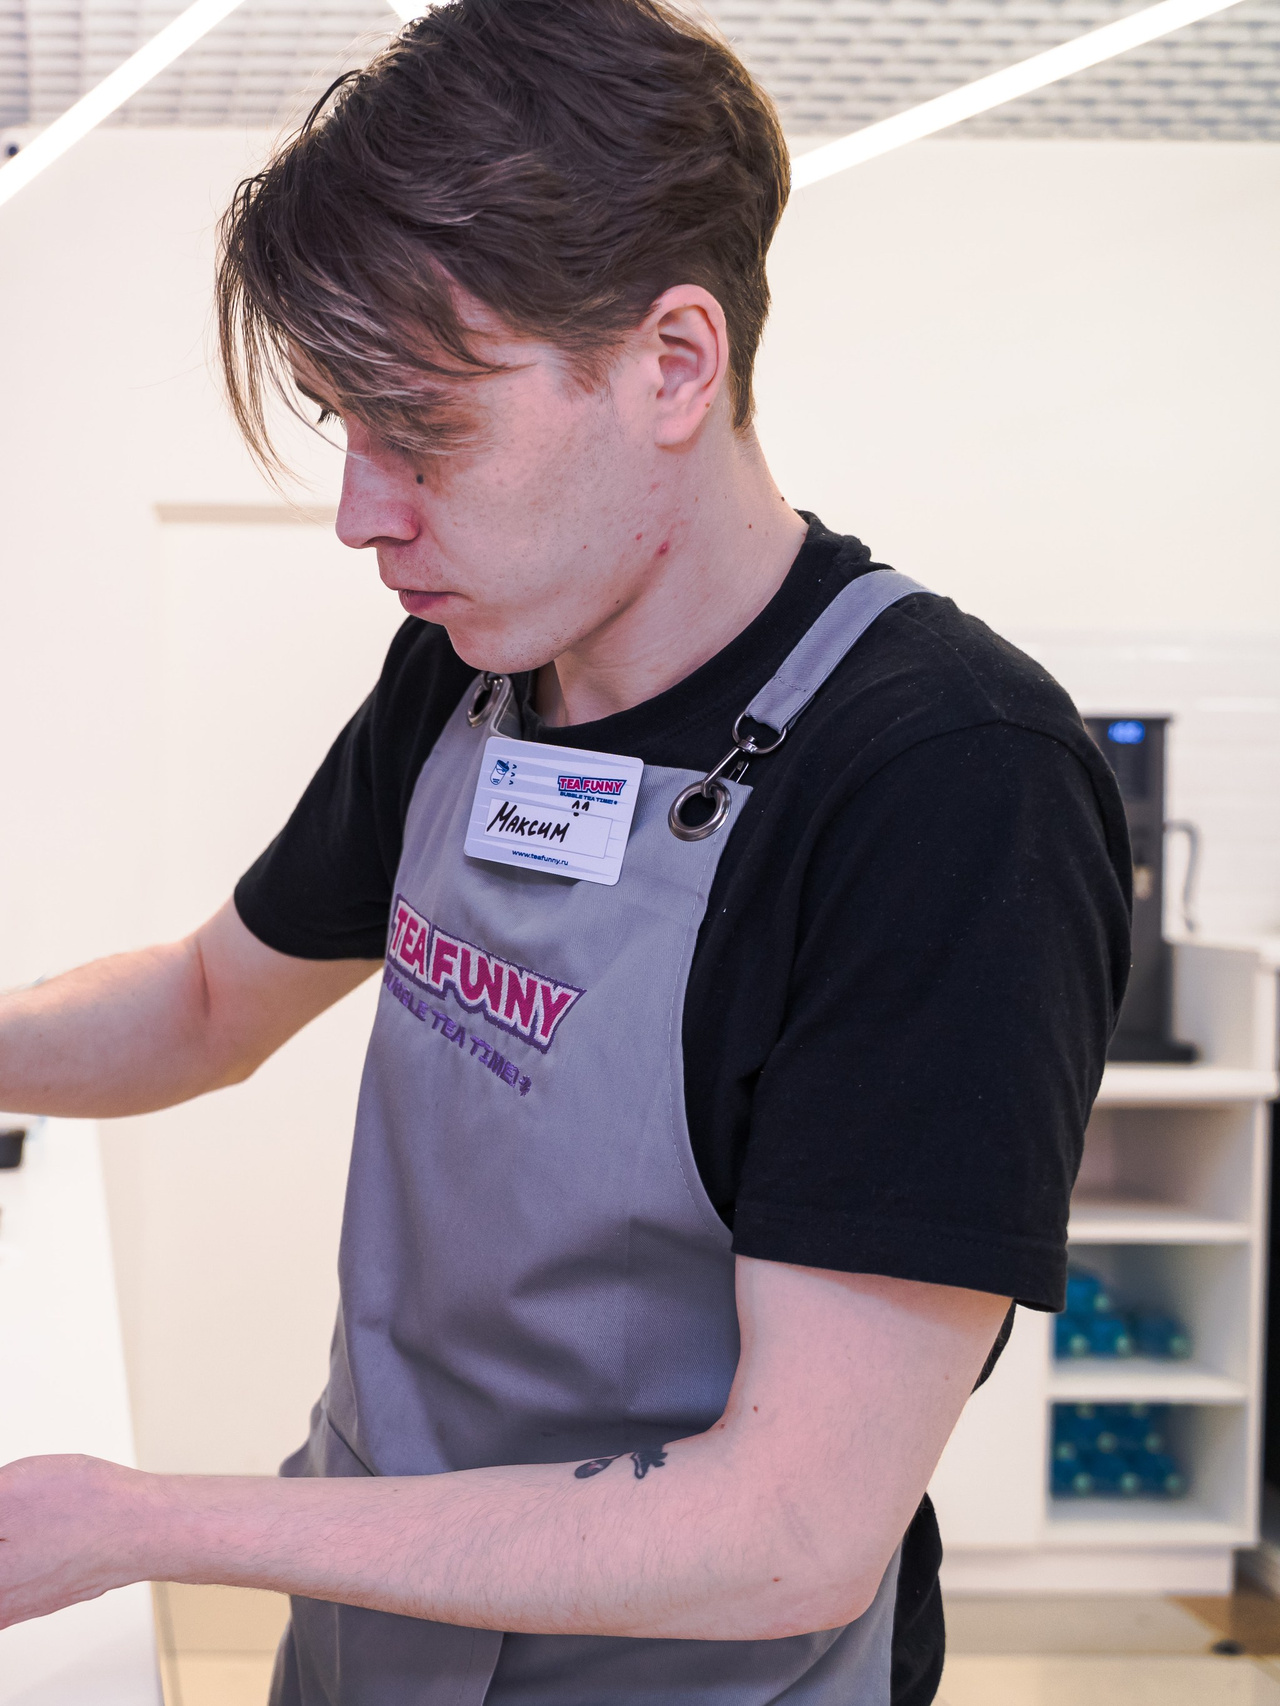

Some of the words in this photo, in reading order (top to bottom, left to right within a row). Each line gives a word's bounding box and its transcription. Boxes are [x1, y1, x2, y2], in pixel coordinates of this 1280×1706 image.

[559, 778, 581, 790] TEA
[582, 780, 623, 793] FUNNY
[512, 850, 569, 866] www.teafunny.ru
[391, 906, 428, 977] TEA
[431, 936, 573, 1040] FUNNY
[431, 1009, 467, 1049] TEA
